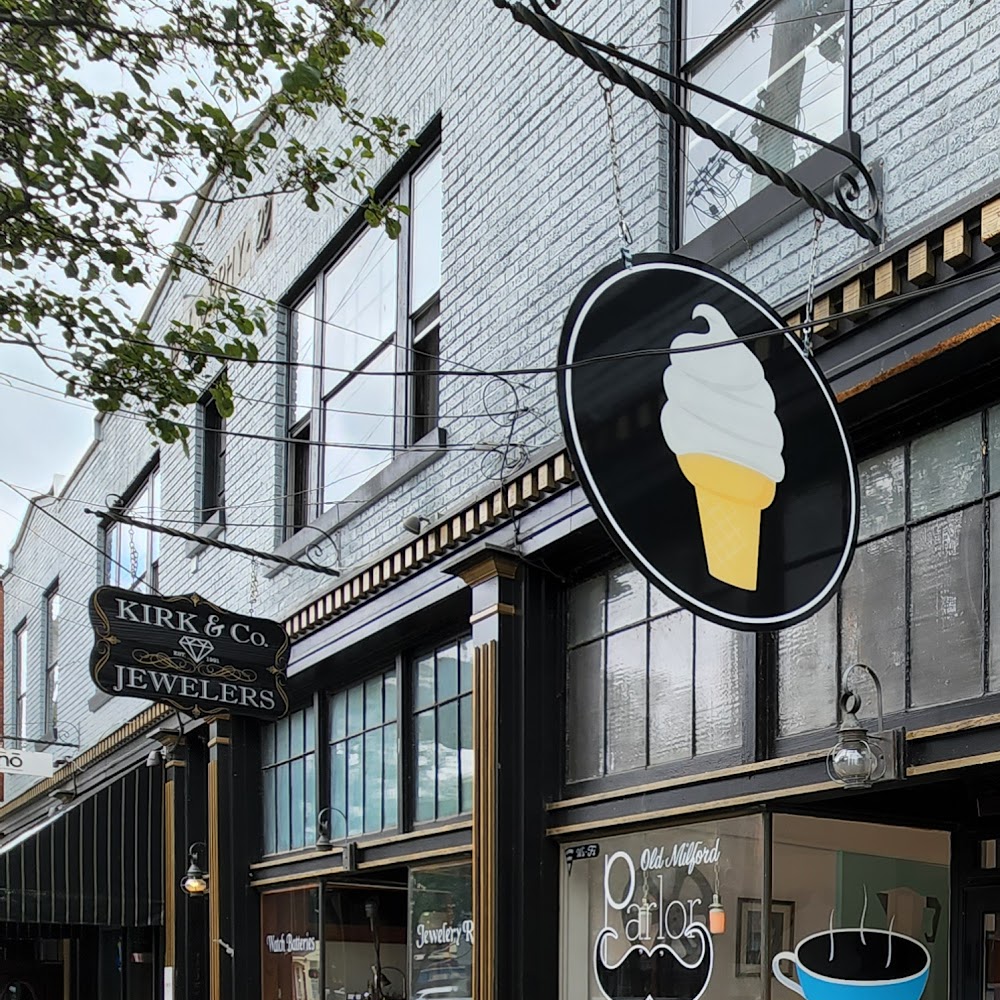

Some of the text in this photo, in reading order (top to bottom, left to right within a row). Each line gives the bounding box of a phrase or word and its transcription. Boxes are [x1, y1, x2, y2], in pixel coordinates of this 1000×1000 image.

[115, 598, 199, 634] KIRK
[204, 614, 225, 638] &
[112, 664, 275, 710] JEWELERS
[640, 838, 720, 875] Old Milford
[604, 851, 702, 966] Parlor
[266, 934, 285, 953] Watch
